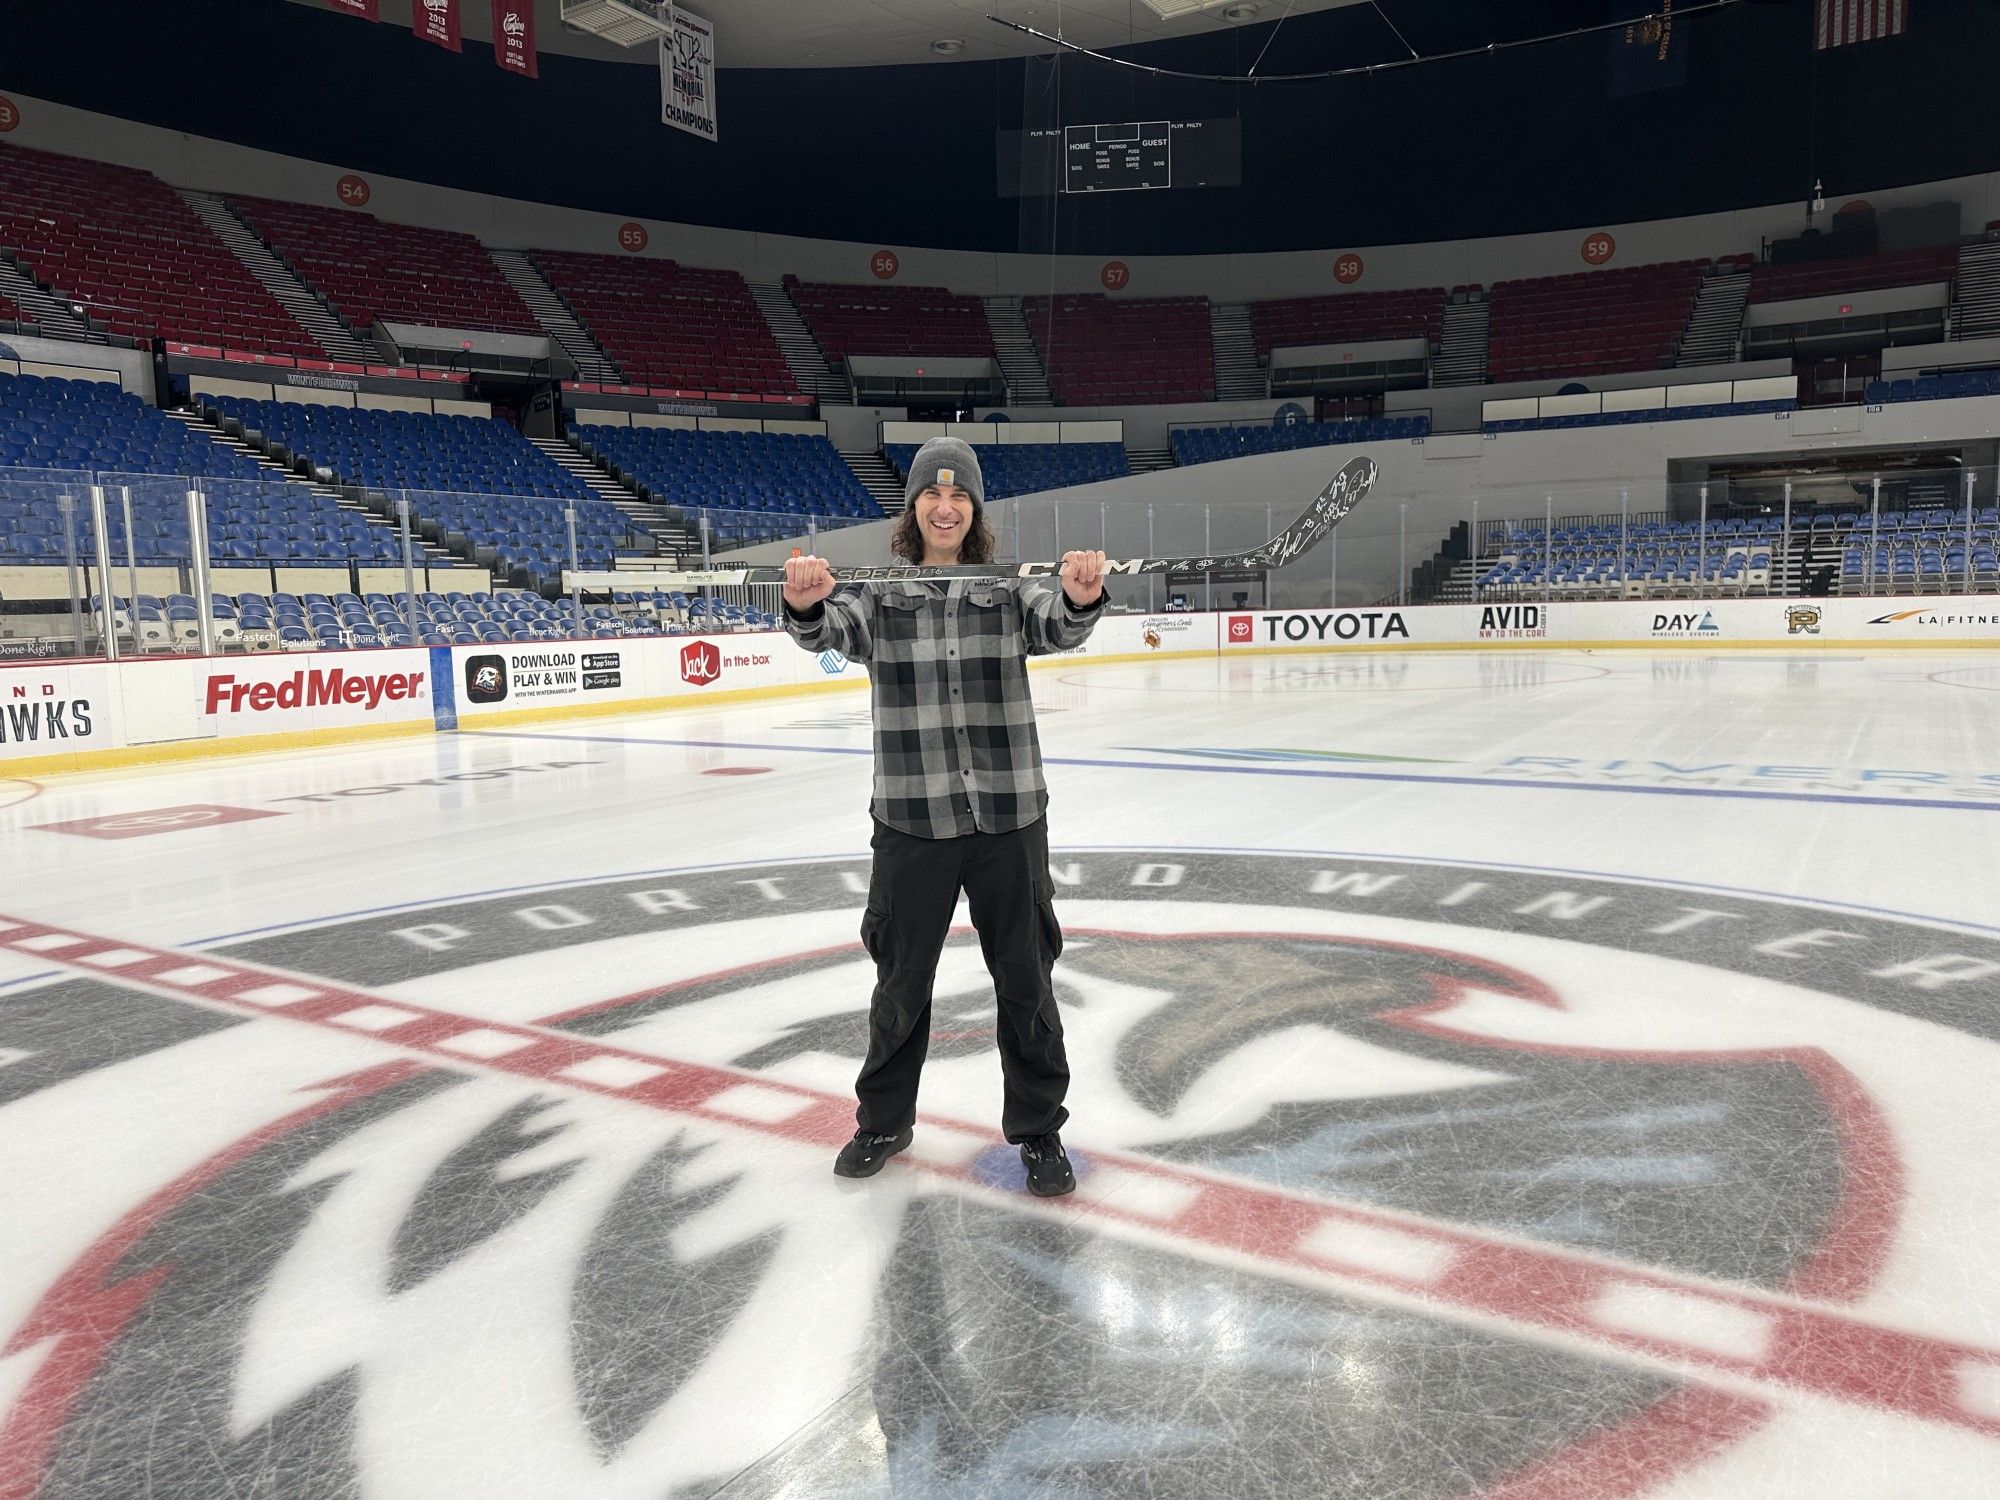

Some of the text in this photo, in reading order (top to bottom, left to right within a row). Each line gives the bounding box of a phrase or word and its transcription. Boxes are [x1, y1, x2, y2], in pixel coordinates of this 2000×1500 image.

[429, 12, 446, 26] 2013
[506, 37, 523, 49] 2013
[665, 103, 714, 135] CHAMPIONS
[1069, 143, 1091, 151] HOME
[1142, 138, 1168, 147] GUEST
[341, 184, 364, 198] 54
[623, 230, 642, 244] 55
[1588, 241, 1608, 256] 59
[876, 258, 893, 273] 56
[1340, 261, 1358, 276] 58
[1107, 269, 1124, 283] 57
[328, 362, 334, 371] 3
[1018, 559, 1145, 578] CM
[1165, 603, 1173, 611] IT
[1480, 606, 1539, 629] AVID
[1652, 614, 1699, 631] DAY
[1918, 616, 1937, 624] LA
[596, 621, 622, 629] Fastech
[624, 626, 654, 634] Solutions
[1262, 612, 1410, 641] TOYOTA
[1480, 630, 1492, 638] NW
[1509, 629, 1524, 637] THE
[1526, 629, 1547, 637] CORE
[236, 630, 401, 649] Fastech Solutions IT Done Right
[27, 643, 57, 658] Right
[512, 653, 576, 669] DOWNLOAD
[592, 659, 619, 668] App Store
[682, 645, 718, 680] Jack
[723, 654, 770, 668] in the box
[513, 671, 577, 688] PLAY & WIN
